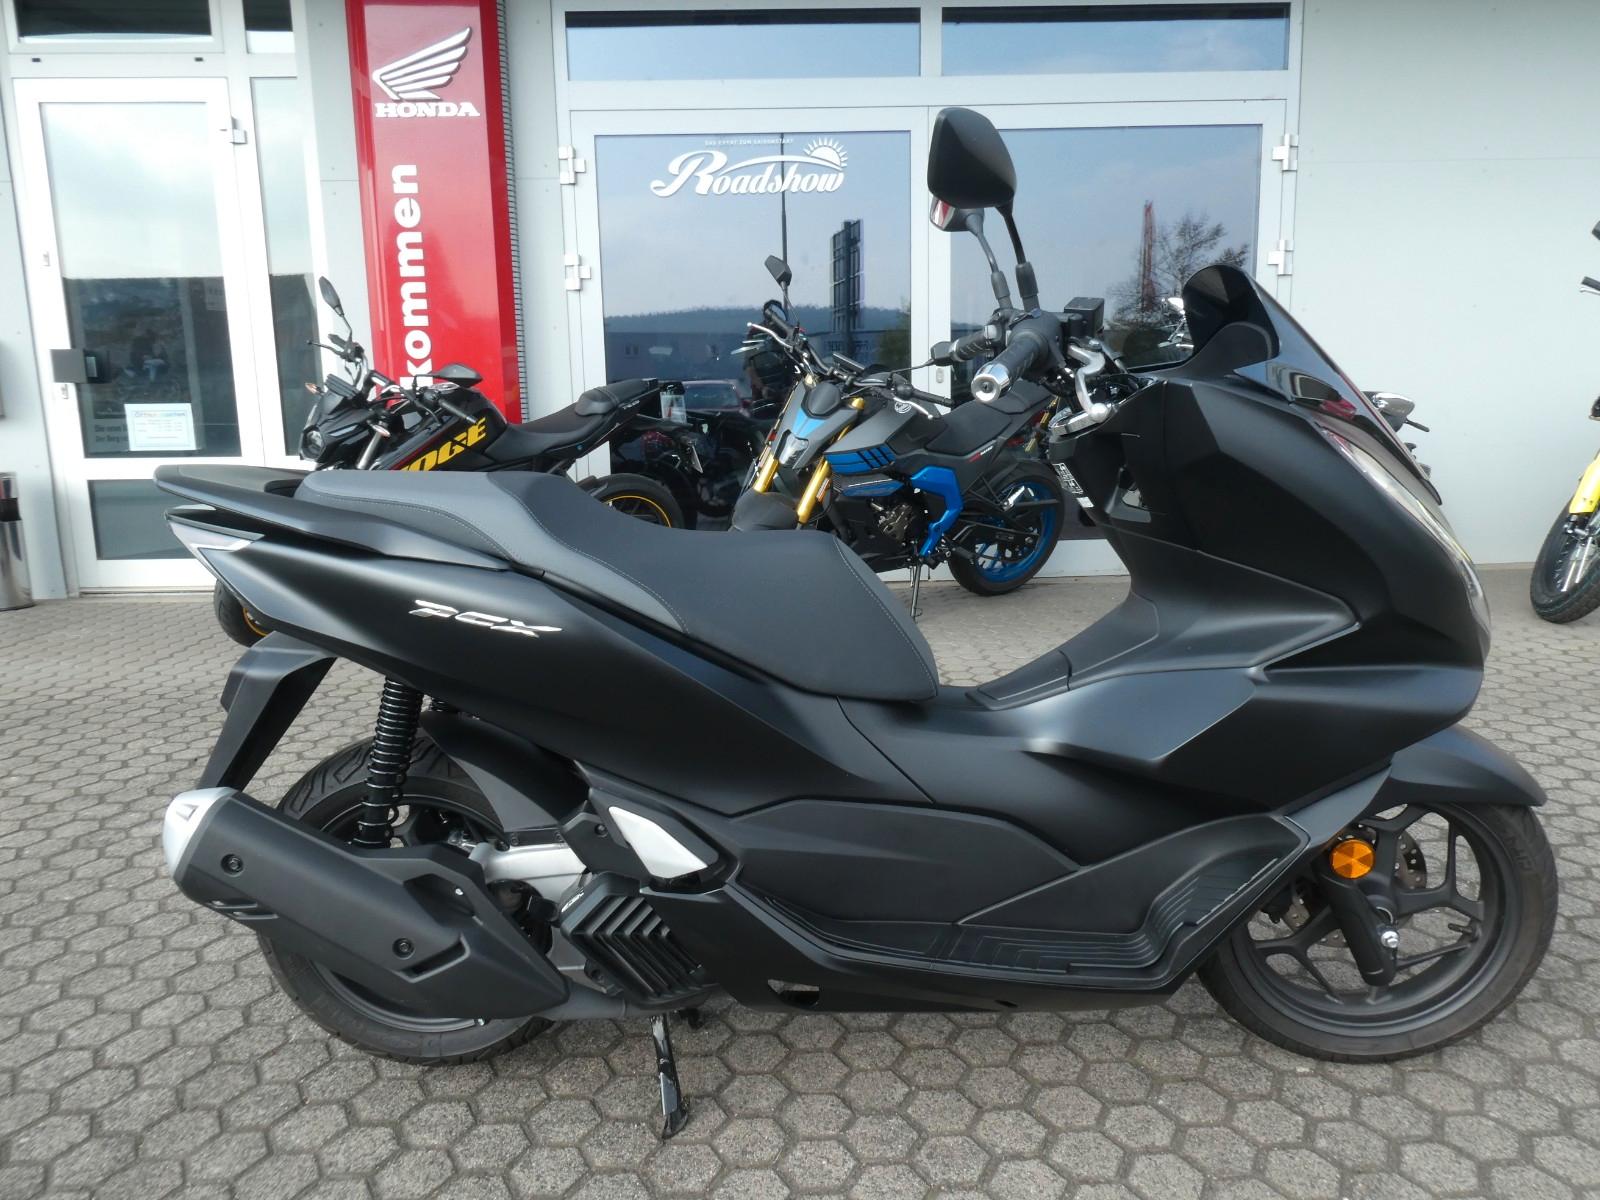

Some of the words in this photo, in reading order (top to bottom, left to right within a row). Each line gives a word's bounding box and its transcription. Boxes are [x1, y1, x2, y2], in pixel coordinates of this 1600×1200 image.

[375, 102, 480, 117] HONDA
[650, 150, 845, 198] Roadshow
[401, 417, 487, 471] OGE
[408, 599, 563, 639] PCX
